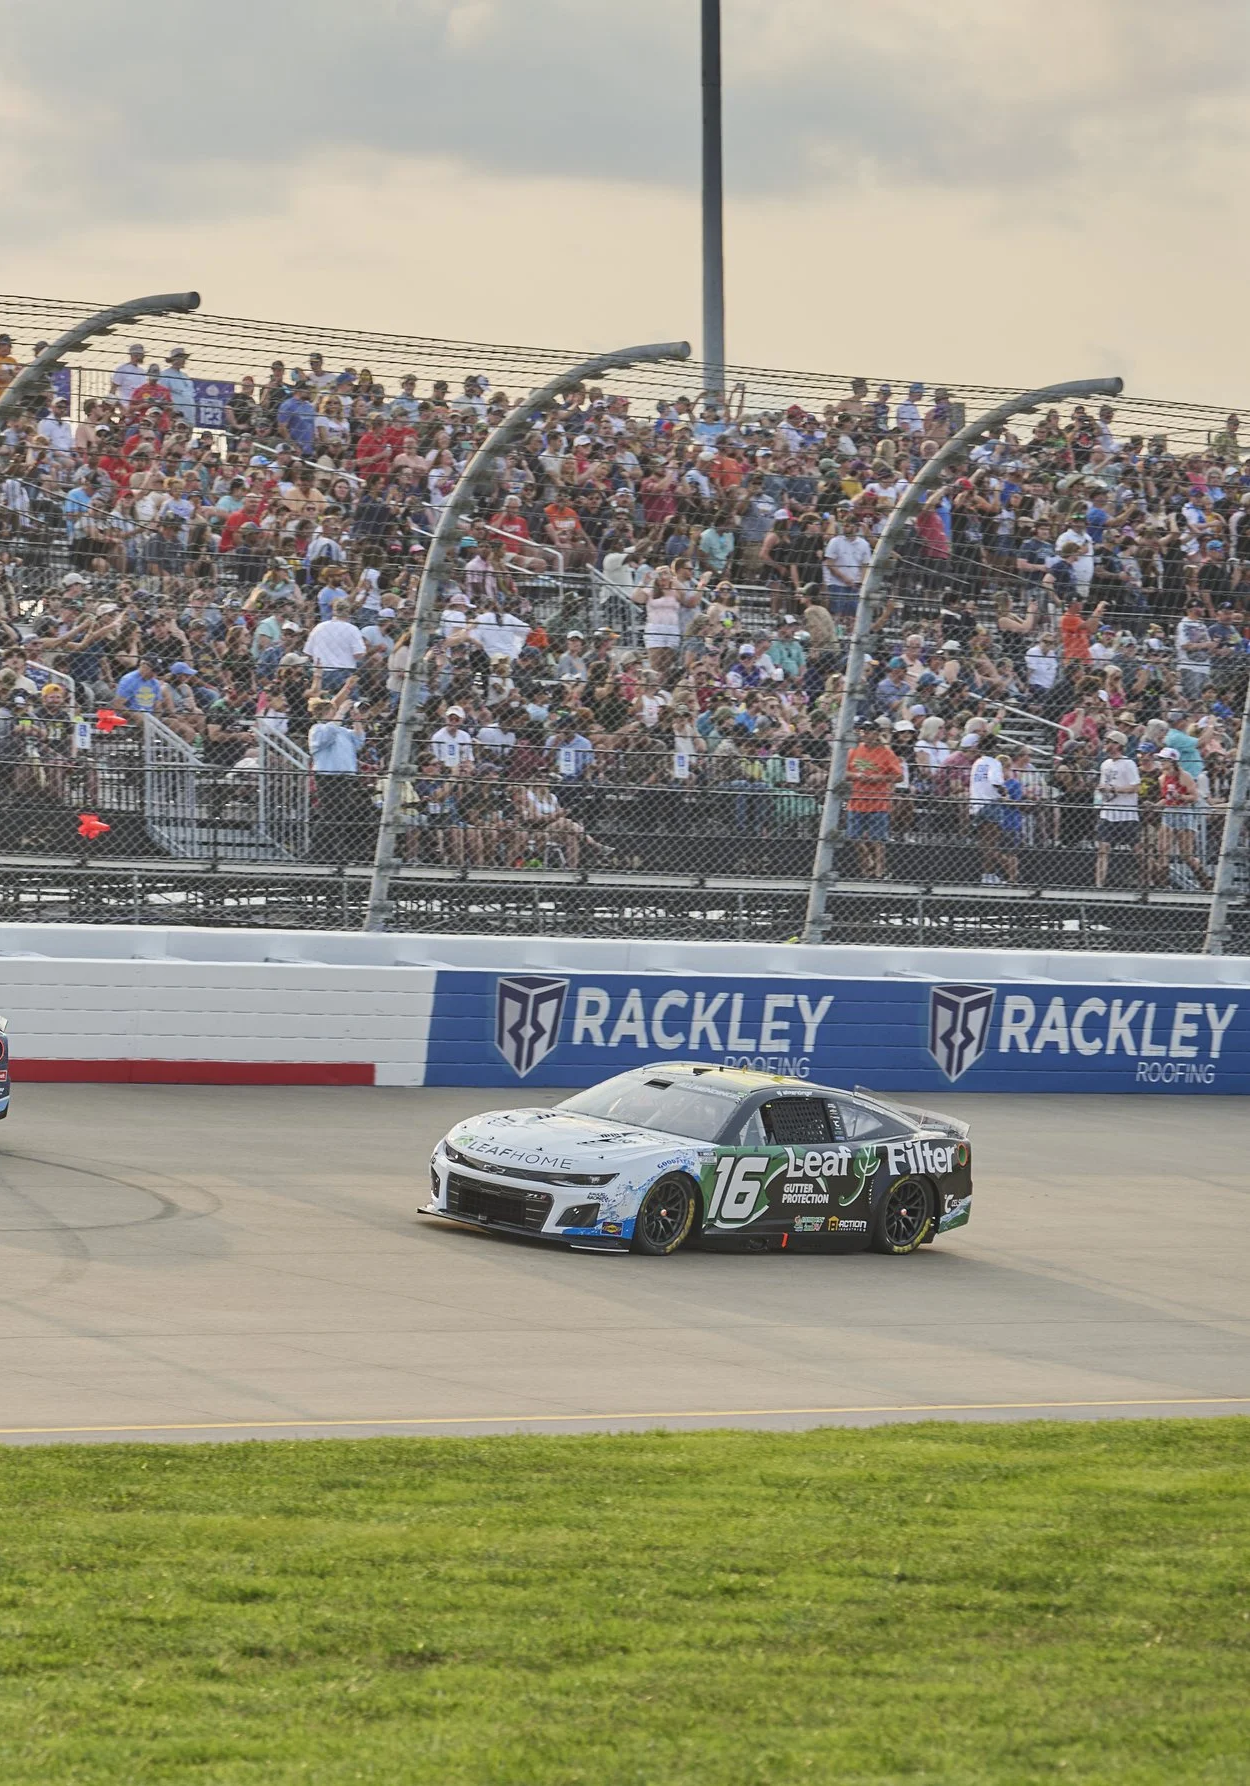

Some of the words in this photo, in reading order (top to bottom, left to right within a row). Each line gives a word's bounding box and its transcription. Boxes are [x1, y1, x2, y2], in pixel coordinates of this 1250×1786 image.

[571, 986, 835, 1053] RACKLEY
[998, 994, 1239, 1059] RACKLEY
[1135, 1061, 1216, 1084] ROOFING
[784, 1145, 852, 1178] Leaf
[886, 1140, 956, 1176] Filter
[707, 1156, 770, 1220] 16
[781, 1193, 830, 1204] PROTECTION
[783, 1183, 814, 1194] GUTTER
[838, 1220, 868, 1229] ACTION
